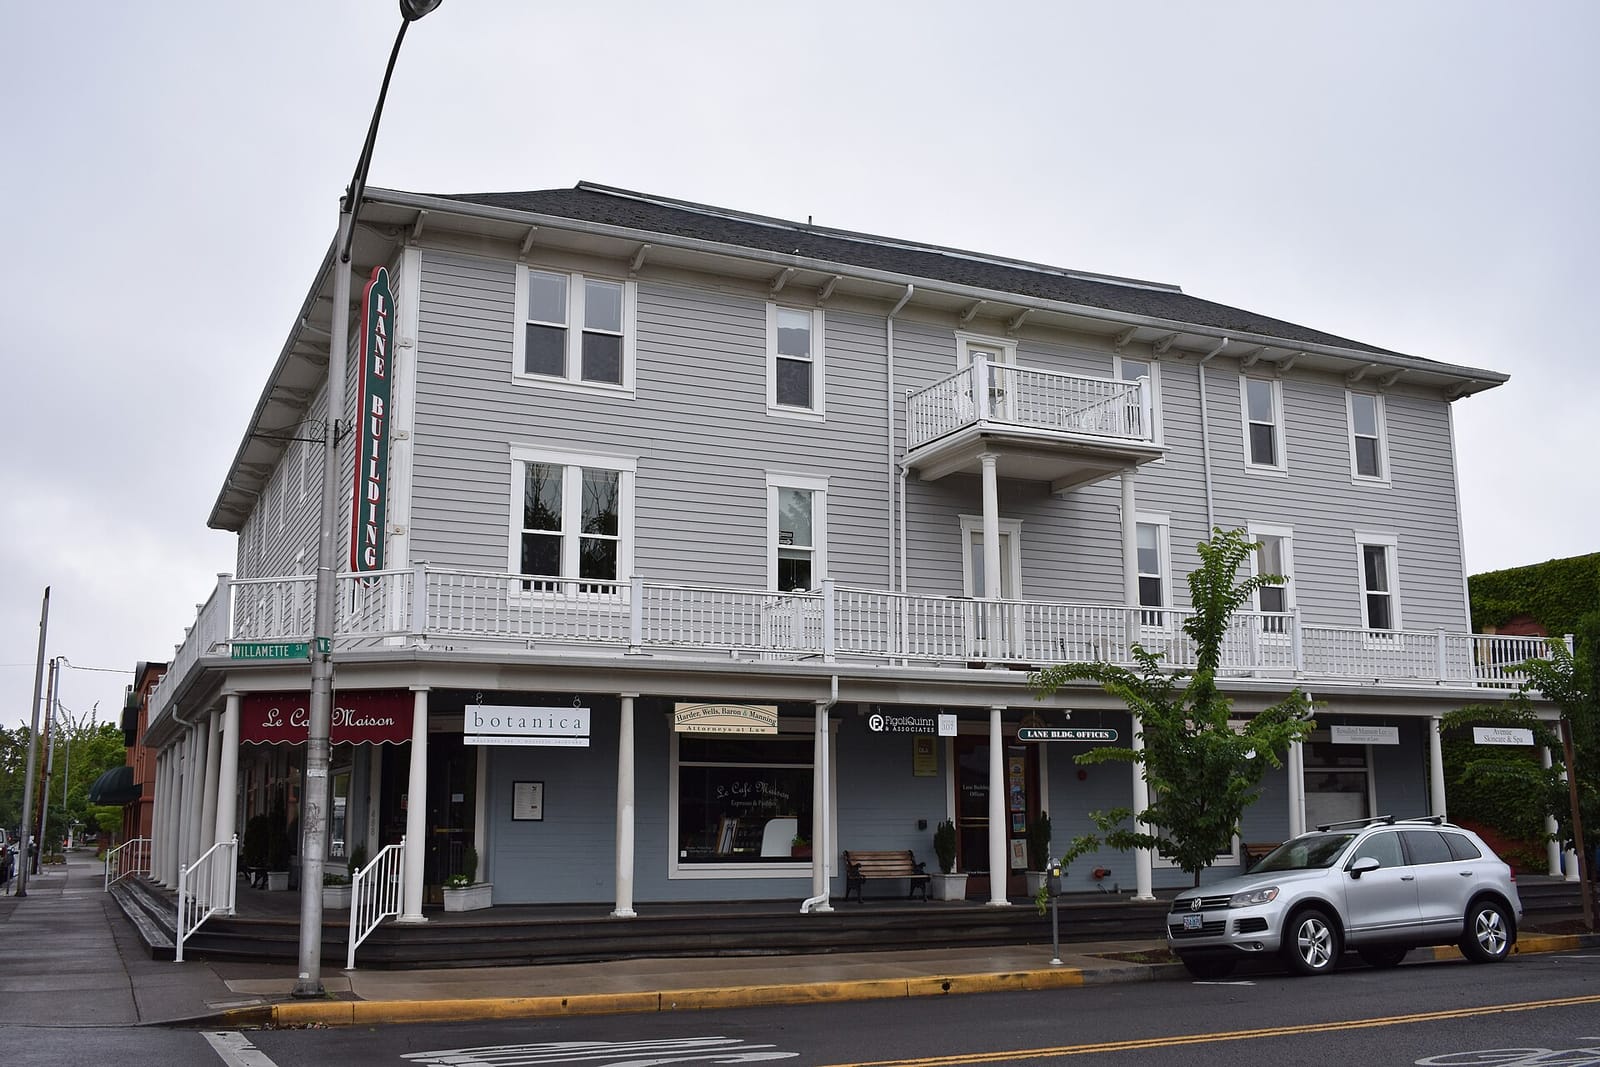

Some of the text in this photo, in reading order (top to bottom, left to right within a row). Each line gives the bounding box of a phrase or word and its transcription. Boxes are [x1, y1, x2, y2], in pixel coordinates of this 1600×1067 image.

[365, 294, 387, 569] LANE BUILDING
[233, 645, 289, 657] WILLAMETTE
[262, 708, 283, 727] Le
[332, 707, 395, 727] Maison
[474, 711, 581, 728] botanica
[677, 711, 702, 722] Harder,
[702, 707, 720, 716] Wells,
[722, 707, 741, 716] Baron
[749, 711, 777, 727] Manning
[686, 725, 732, 733] Attorneys
[1027, 730, 1109, 739] LANE BLDG. OFFICES
[1512, 736, 1523, 744] Spa
